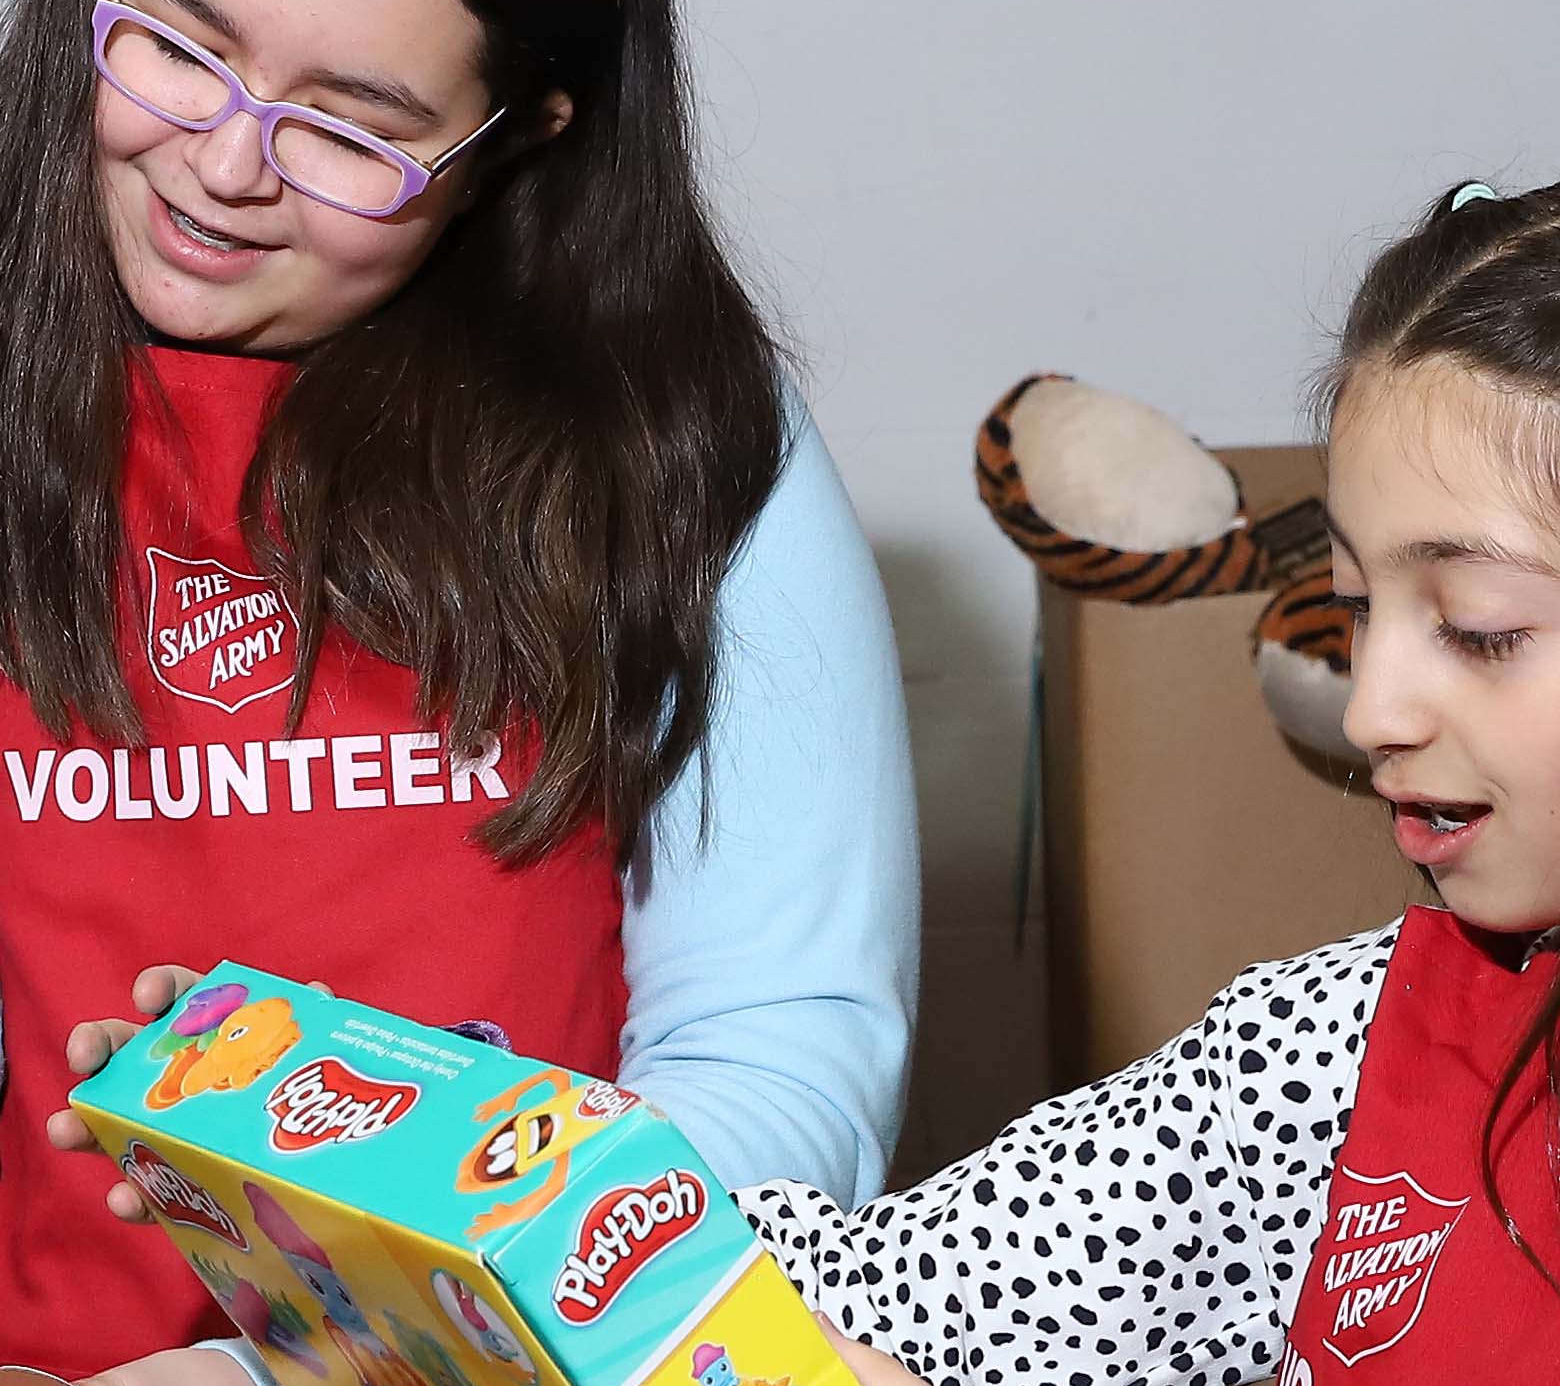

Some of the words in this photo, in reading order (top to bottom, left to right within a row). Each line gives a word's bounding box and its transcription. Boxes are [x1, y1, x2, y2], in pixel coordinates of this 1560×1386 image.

[157, 587, 282, 669] SALVATION
[174, 572, 232, 612] THE
[207, 619, 286, 692] ARMY
[3, 727, 511, 823] VOLUNTEER
[556, 1170, 707, 1316] Play-Doh
[1334, 1195, 1408, 1243] THE
[1322, 1222, 1452, 1293] ALVATION
[1331, 1266, 1423, 1337] ARMY
